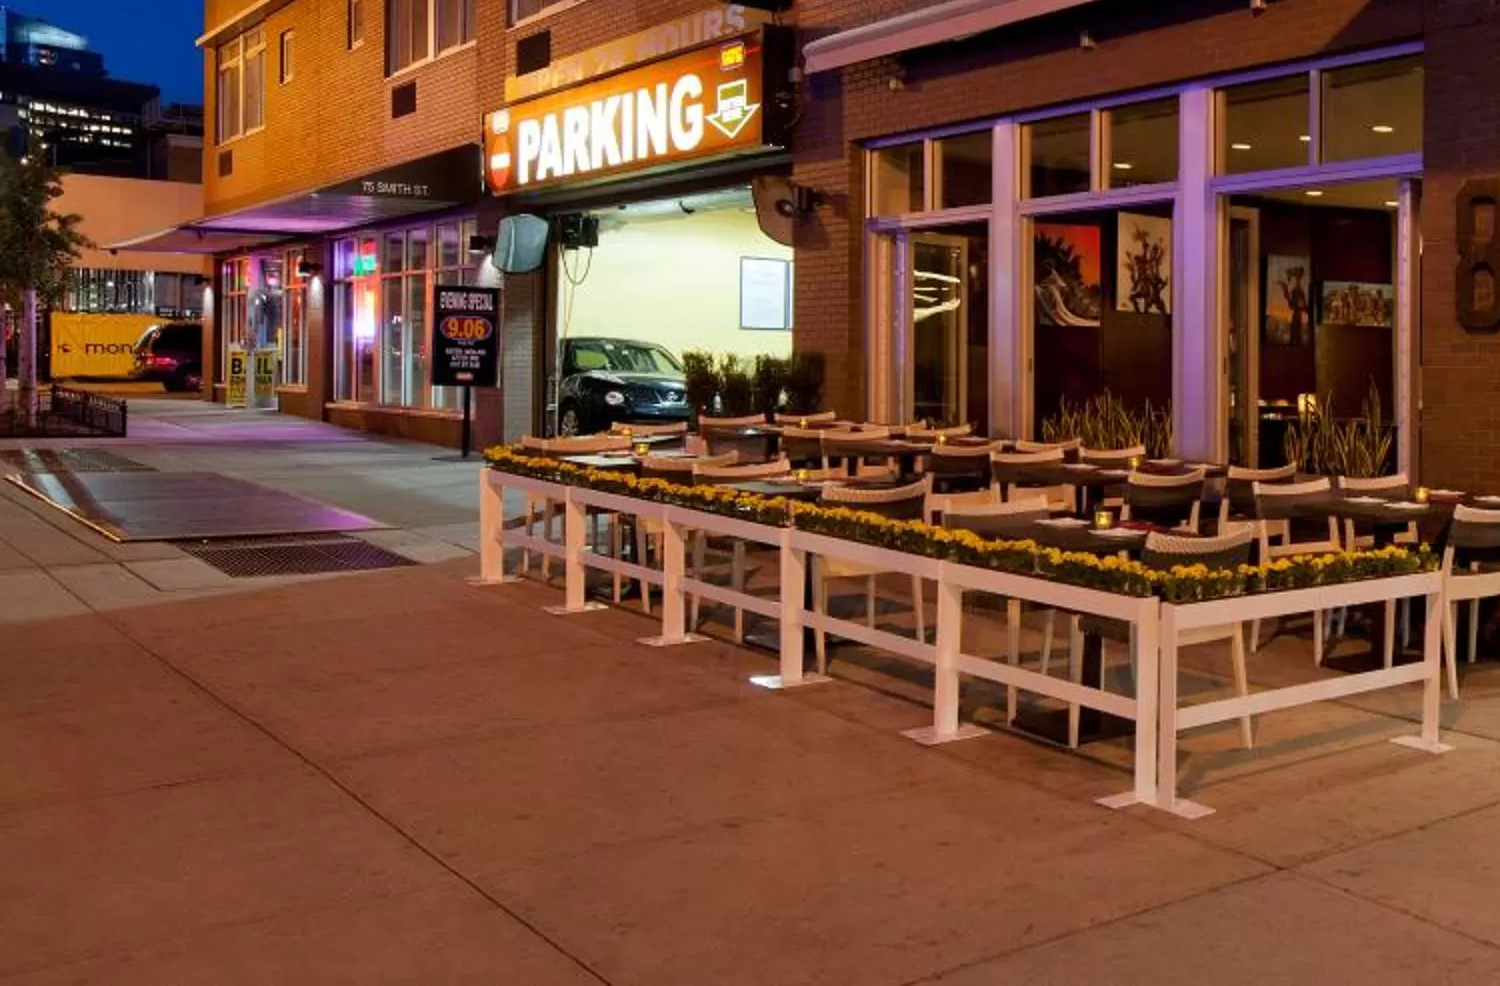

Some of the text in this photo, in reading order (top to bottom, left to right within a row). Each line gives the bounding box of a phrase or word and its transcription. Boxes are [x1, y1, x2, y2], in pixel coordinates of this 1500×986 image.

[517, 73, 704, 184] PARKING
[377, 182, 411, 195] SMITH
[447, 317, 485, 340] 9.06
[231, 357, 273, 375] BIL
